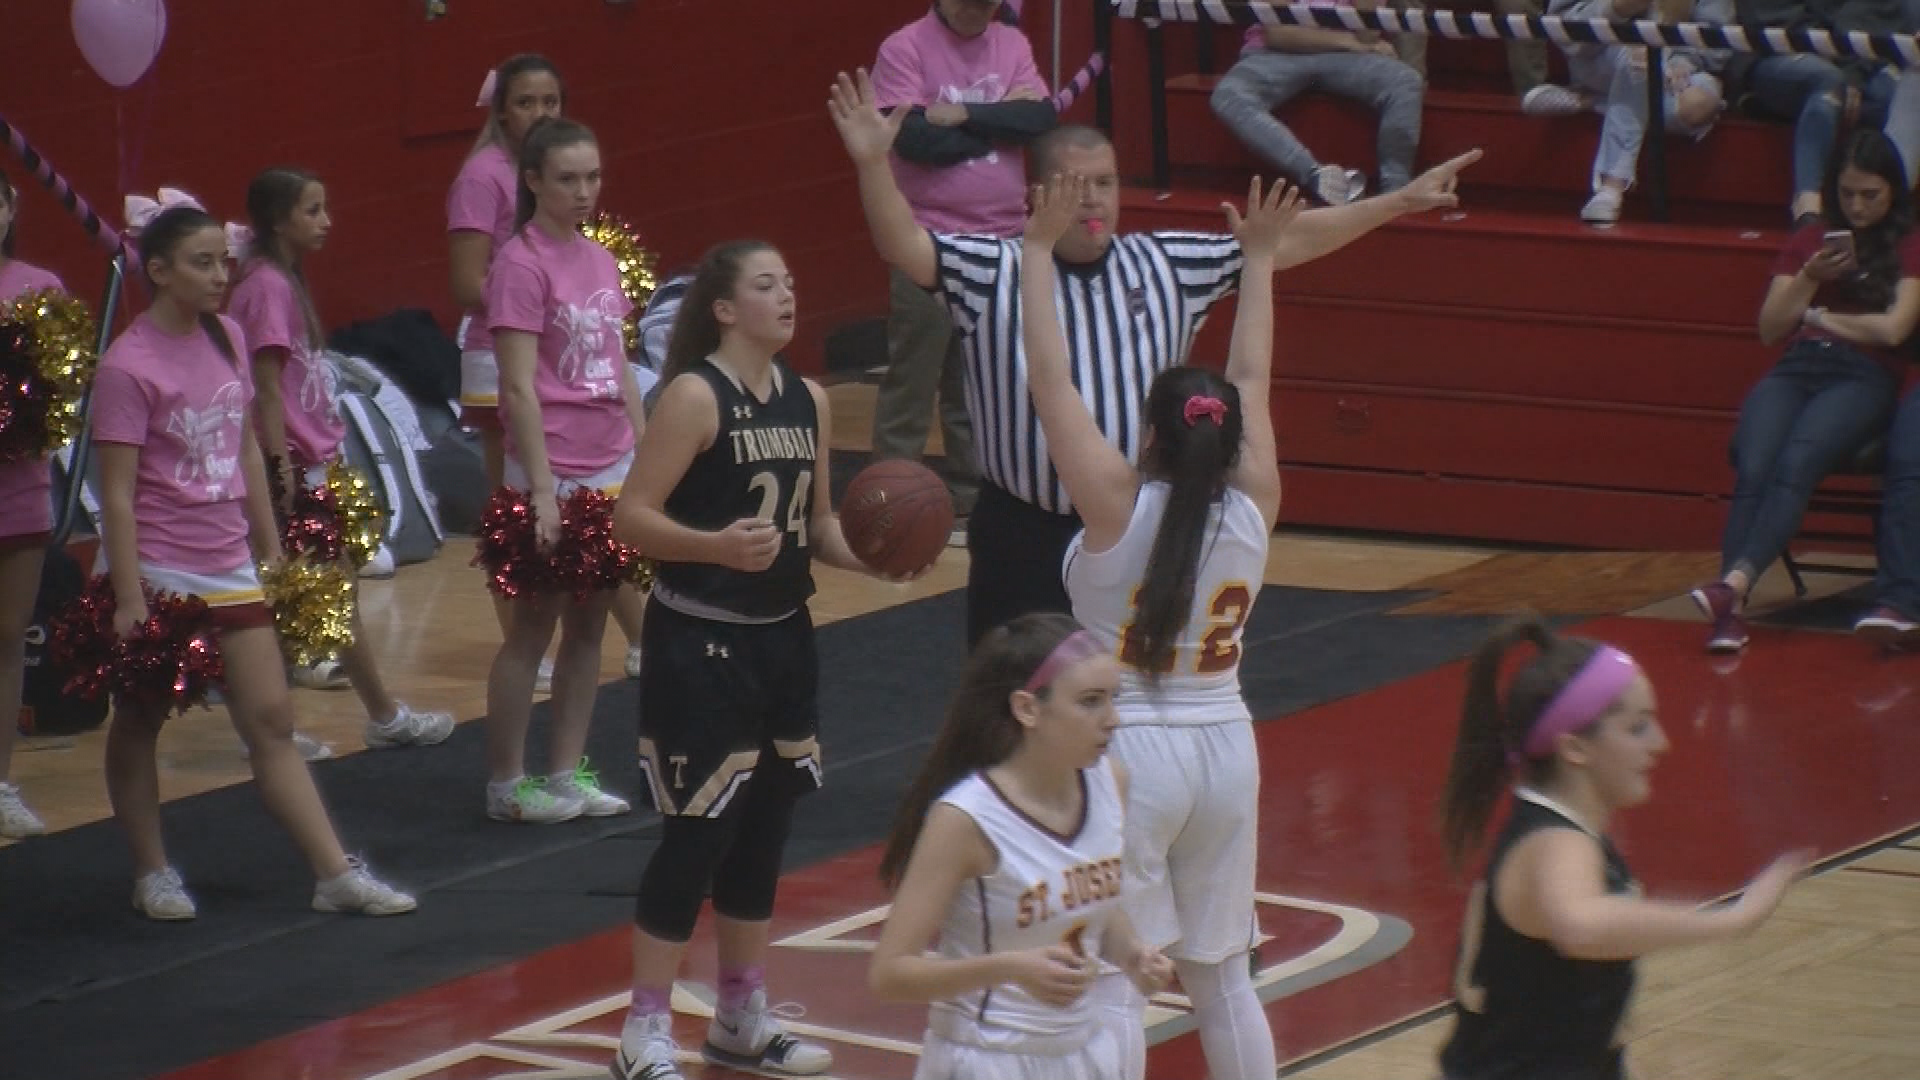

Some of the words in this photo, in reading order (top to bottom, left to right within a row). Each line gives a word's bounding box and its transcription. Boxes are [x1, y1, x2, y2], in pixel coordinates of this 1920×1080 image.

[746, 470, 813, 548] 24
[668, 754, 689, 789] T
[1016, 880, 1057, 930] ST.
